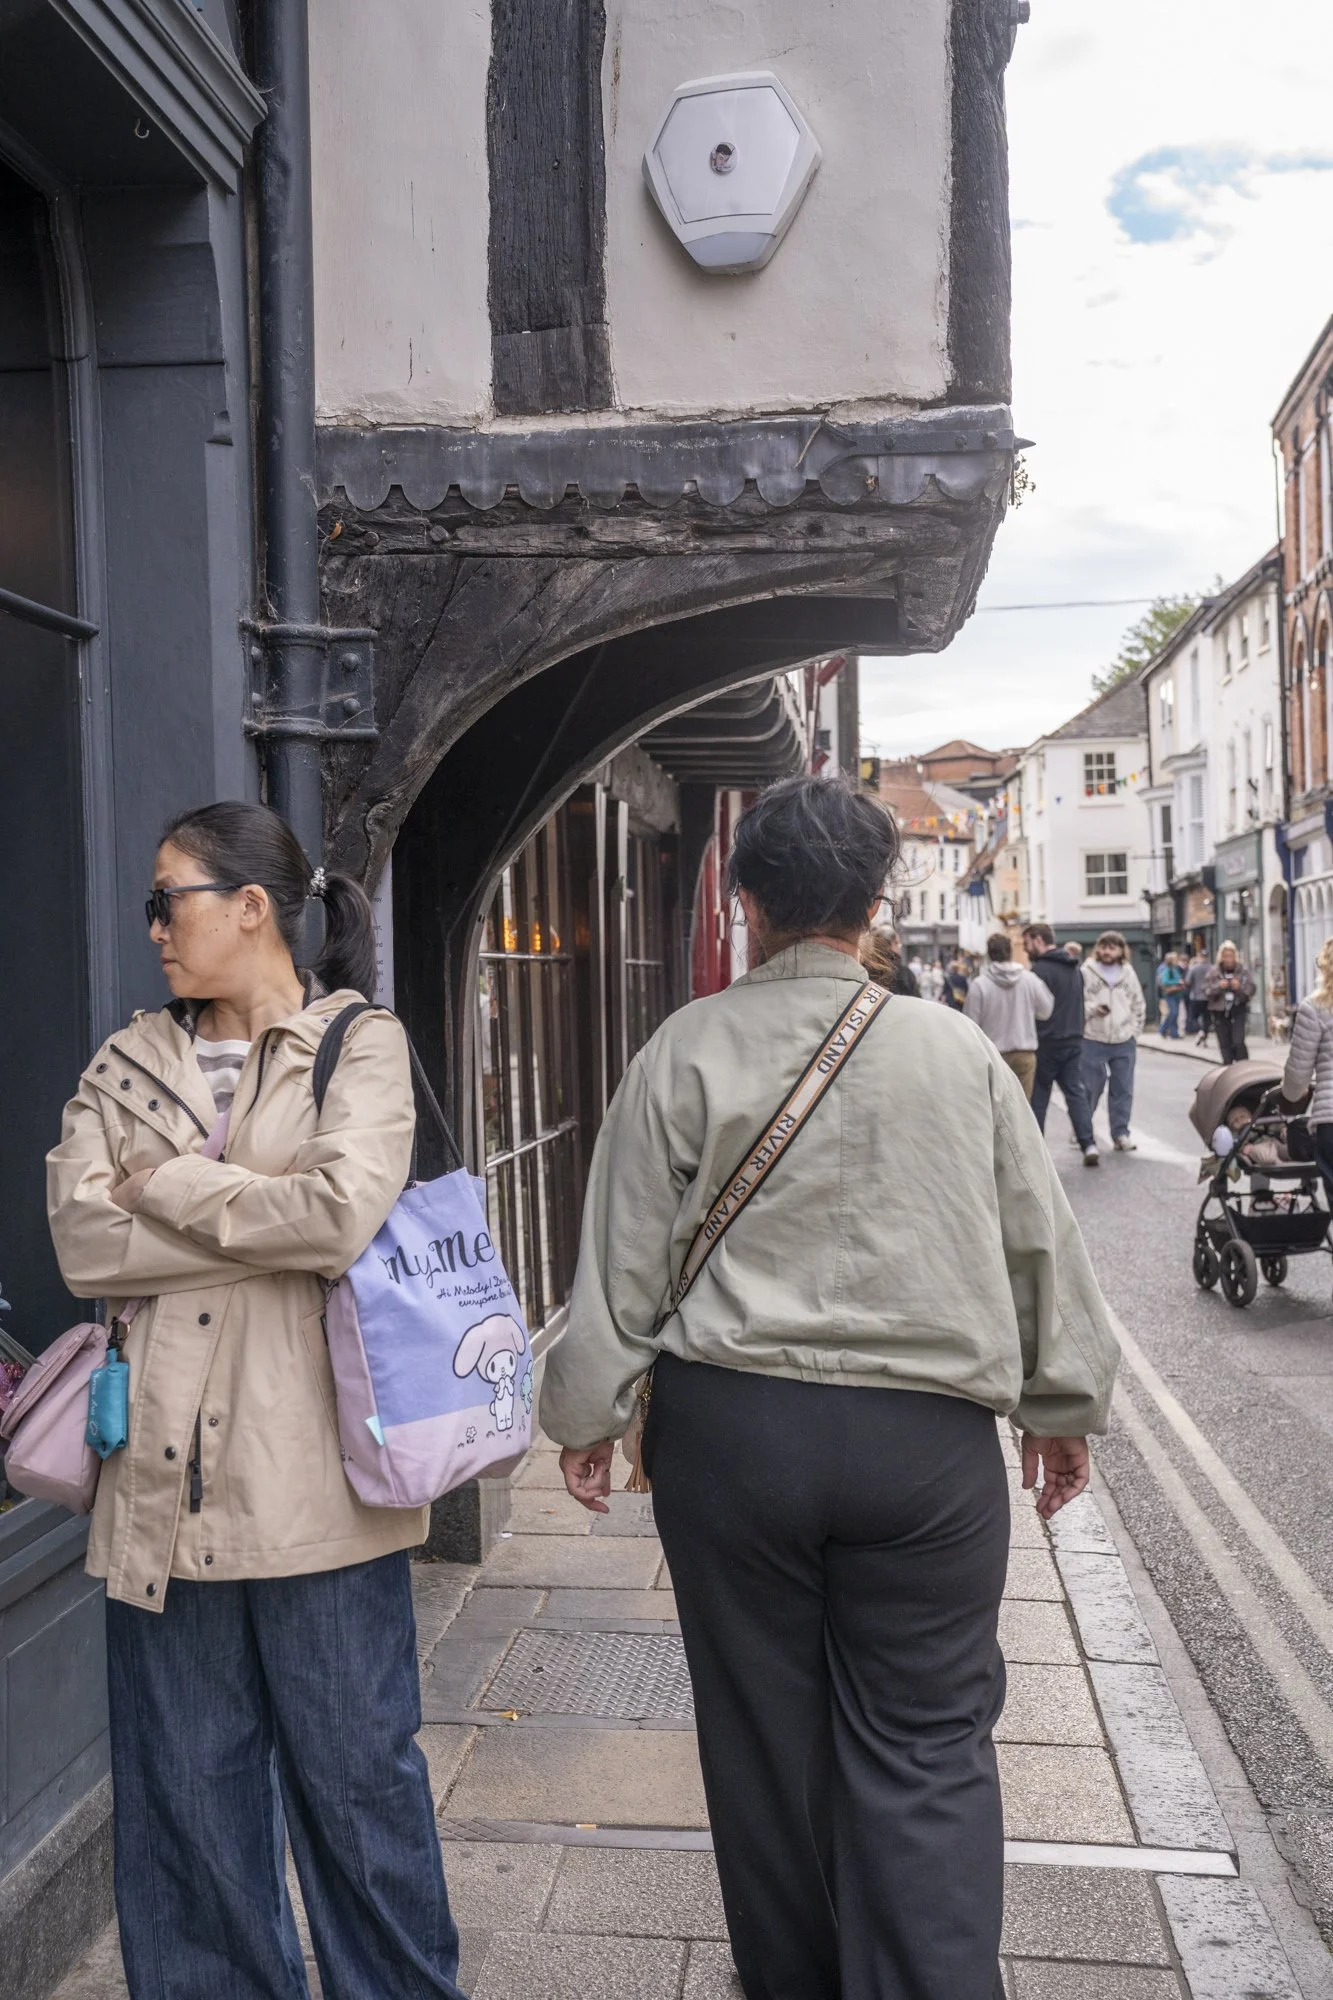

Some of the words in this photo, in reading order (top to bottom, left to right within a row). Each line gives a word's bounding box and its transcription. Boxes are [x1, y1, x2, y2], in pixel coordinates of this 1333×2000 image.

[816, 1008, 867, 1074] ISLAND
[750, 1113, 797, 1171] RIVER
[704, 1178, 751, 1241] ISLAND
[436, 1287, 451, 1299] Hi
[458, 1294, 498, 1308] everyone
